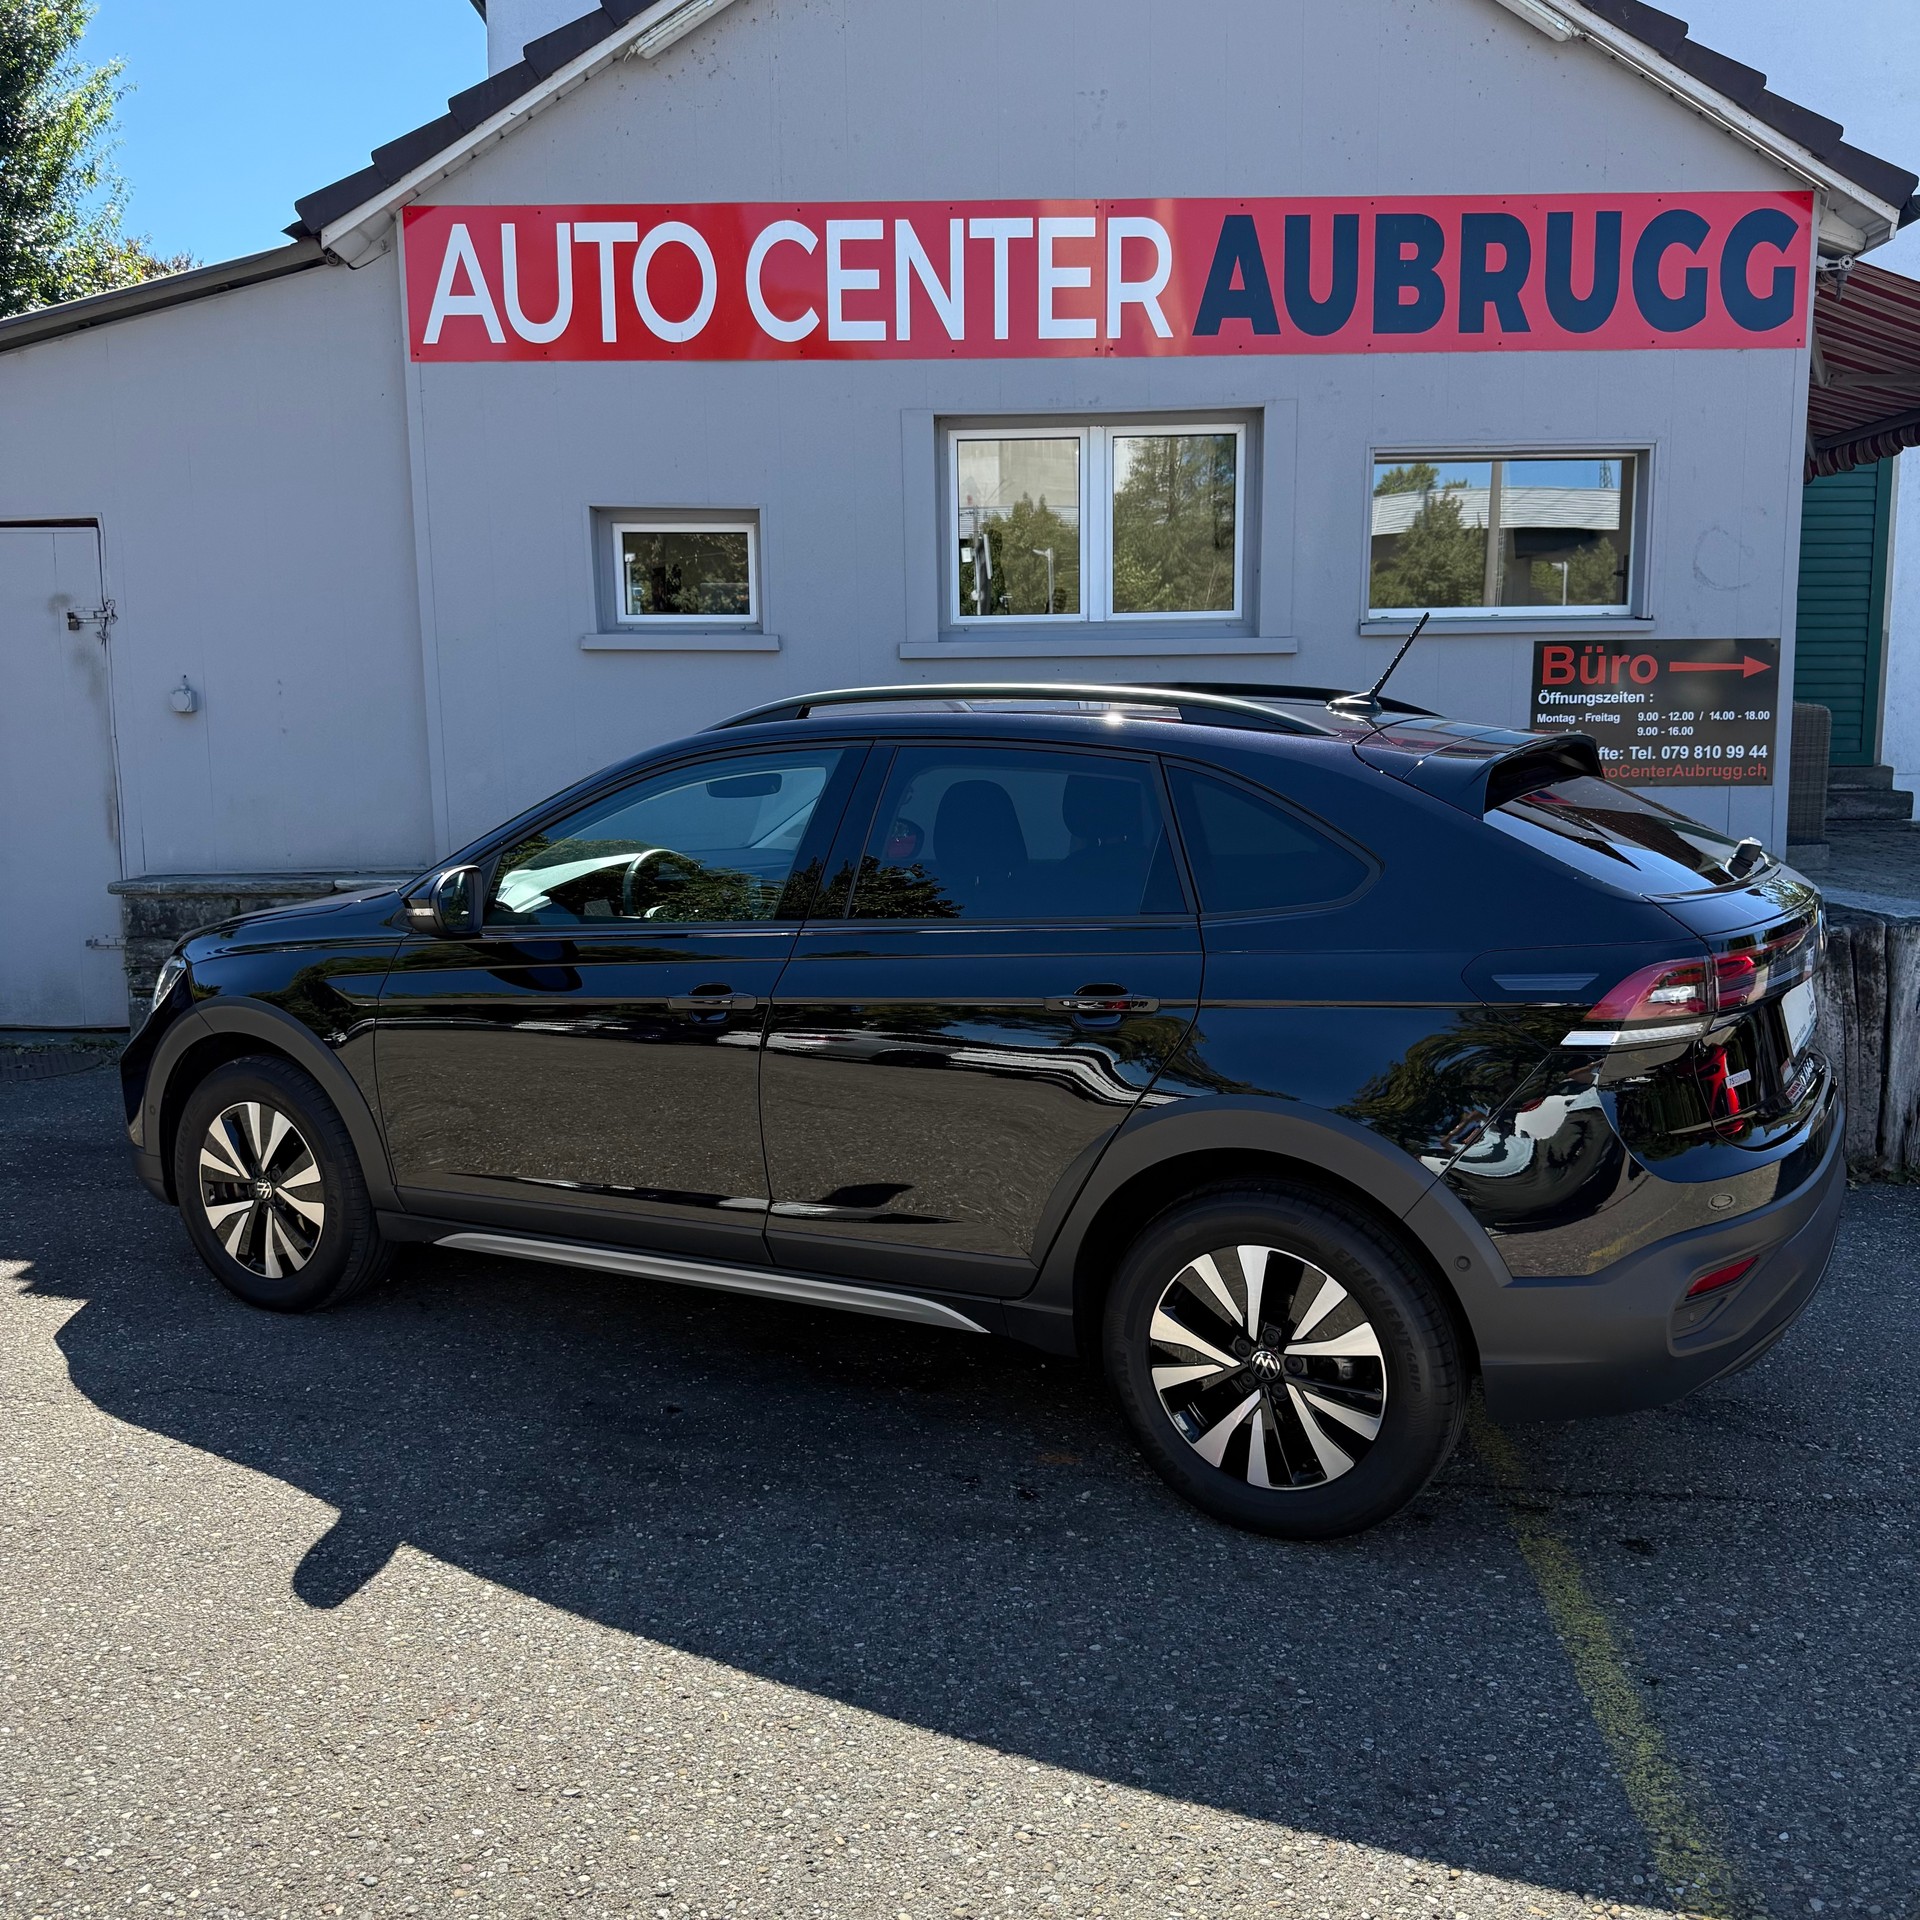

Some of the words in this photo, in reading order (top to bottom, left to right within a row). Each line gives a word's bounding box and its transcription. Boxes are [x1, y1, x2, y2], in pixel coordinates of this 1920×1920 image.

[422, 220, 718, 345] AUTO
[744, 216, 1174, 343] CENTER
[1191, 207, 1800, 337] AUBRUGG
[1541, 645, 1659, 686] Büro
[1537, 689, 1645, 706] Öffnungszeiten
[1536, 713, 1576, 725] Montag
[1584, 712, 1621, 724] Freitag
[1637, 711, 1659, 722] 9.00
[1668, 711, 1695, 721] 12.00
[1709, 711, 1736, 721] 14.00
[1744, 710, 1771, 721] 18.00
[1636, 726, 1659, 736] 9.00
[1667, 726, 1694, 736] 16.00
[1629, 746, 1656, 760] Tel.
[1661, 745, 1689, 760] 079
[1693, 745, 1722, 759] 810
[1726, 745, 1745, 759] 99
[1749, 744, 1769, 758] 44
